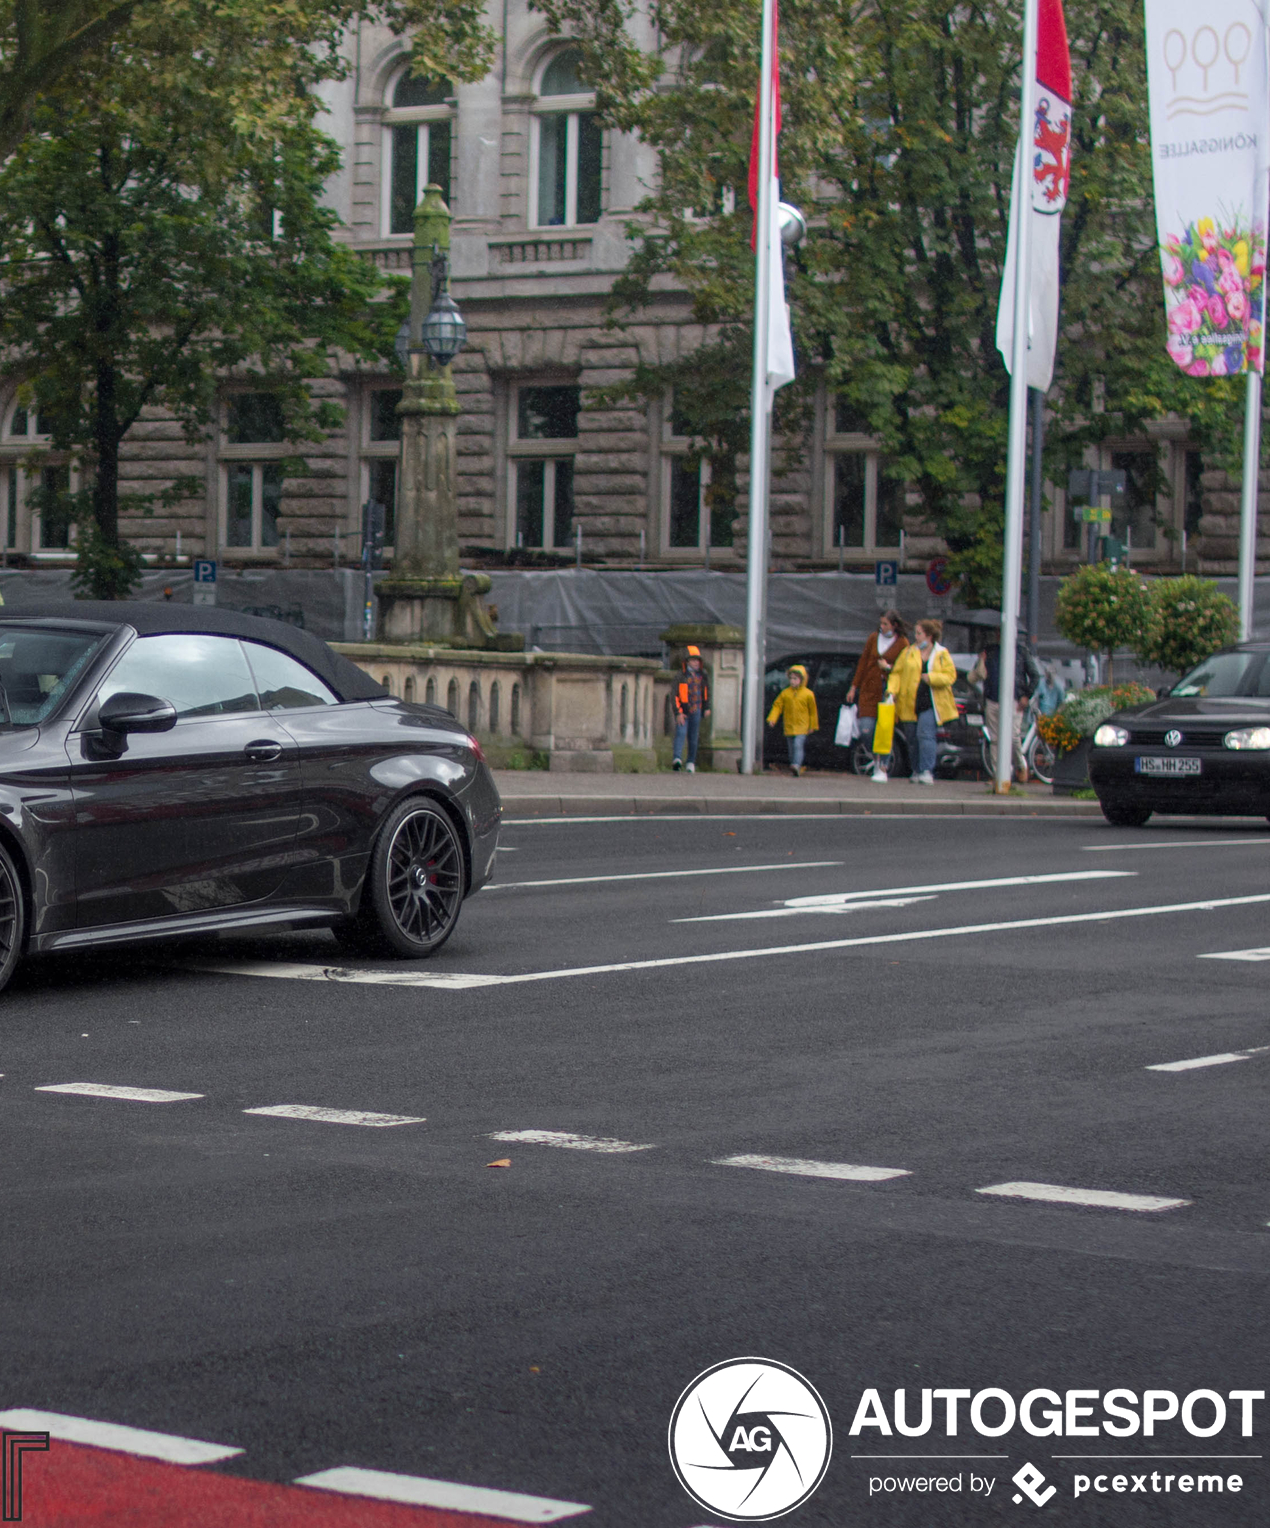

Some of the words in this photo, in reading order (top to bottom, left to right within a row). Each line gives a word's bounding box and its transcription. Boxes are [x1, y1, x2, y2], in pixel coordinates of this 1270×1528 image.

[199, 563, 212, 581] P
[881, 564, 893, 584] P
[1141, 758, 1155, 770] HS
[1162, 758, 1176, 771] HH
[1178, 758, 1199, 771] 255
